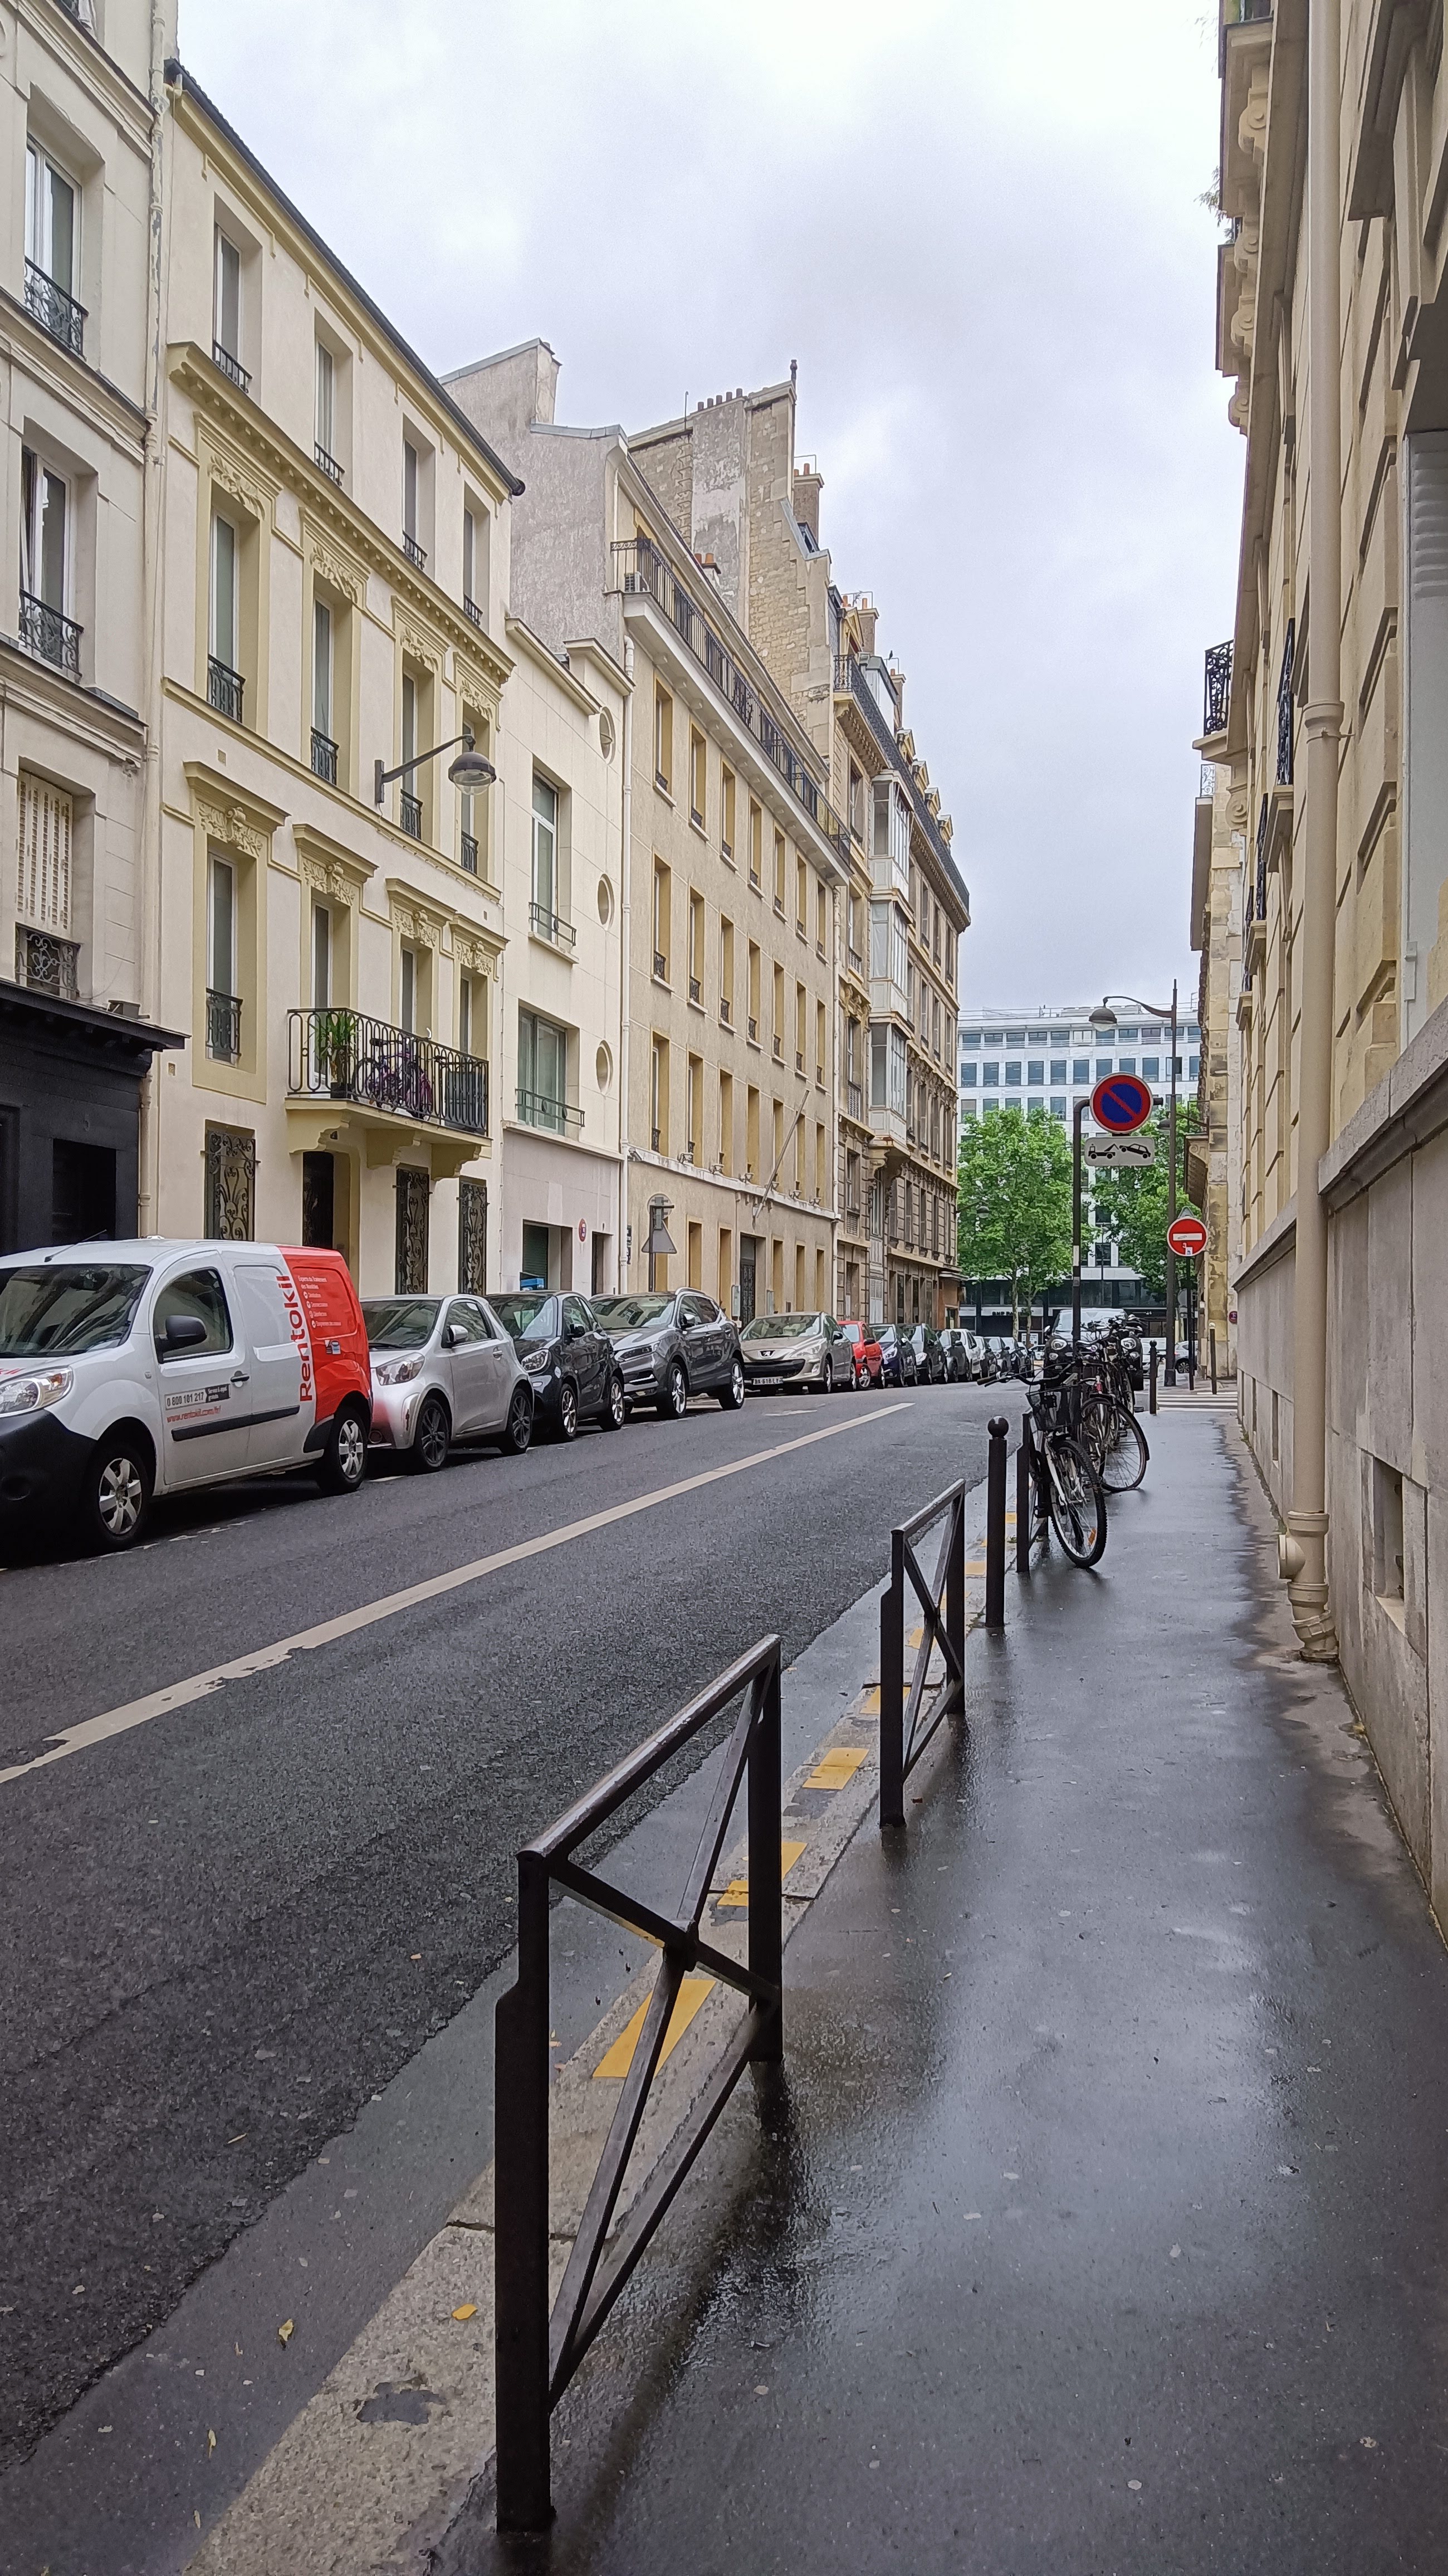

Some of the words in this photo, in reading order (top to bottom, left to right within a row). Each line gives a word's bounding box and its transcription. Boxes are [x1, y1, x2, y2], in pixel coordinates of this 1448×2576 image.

[276, 1276, 312, 1402] Rentokil
[167, 1398, 170, 1407] 0
[184, 1394, 193, 1403] 101
[194, 1392, 204, 1402] 217
